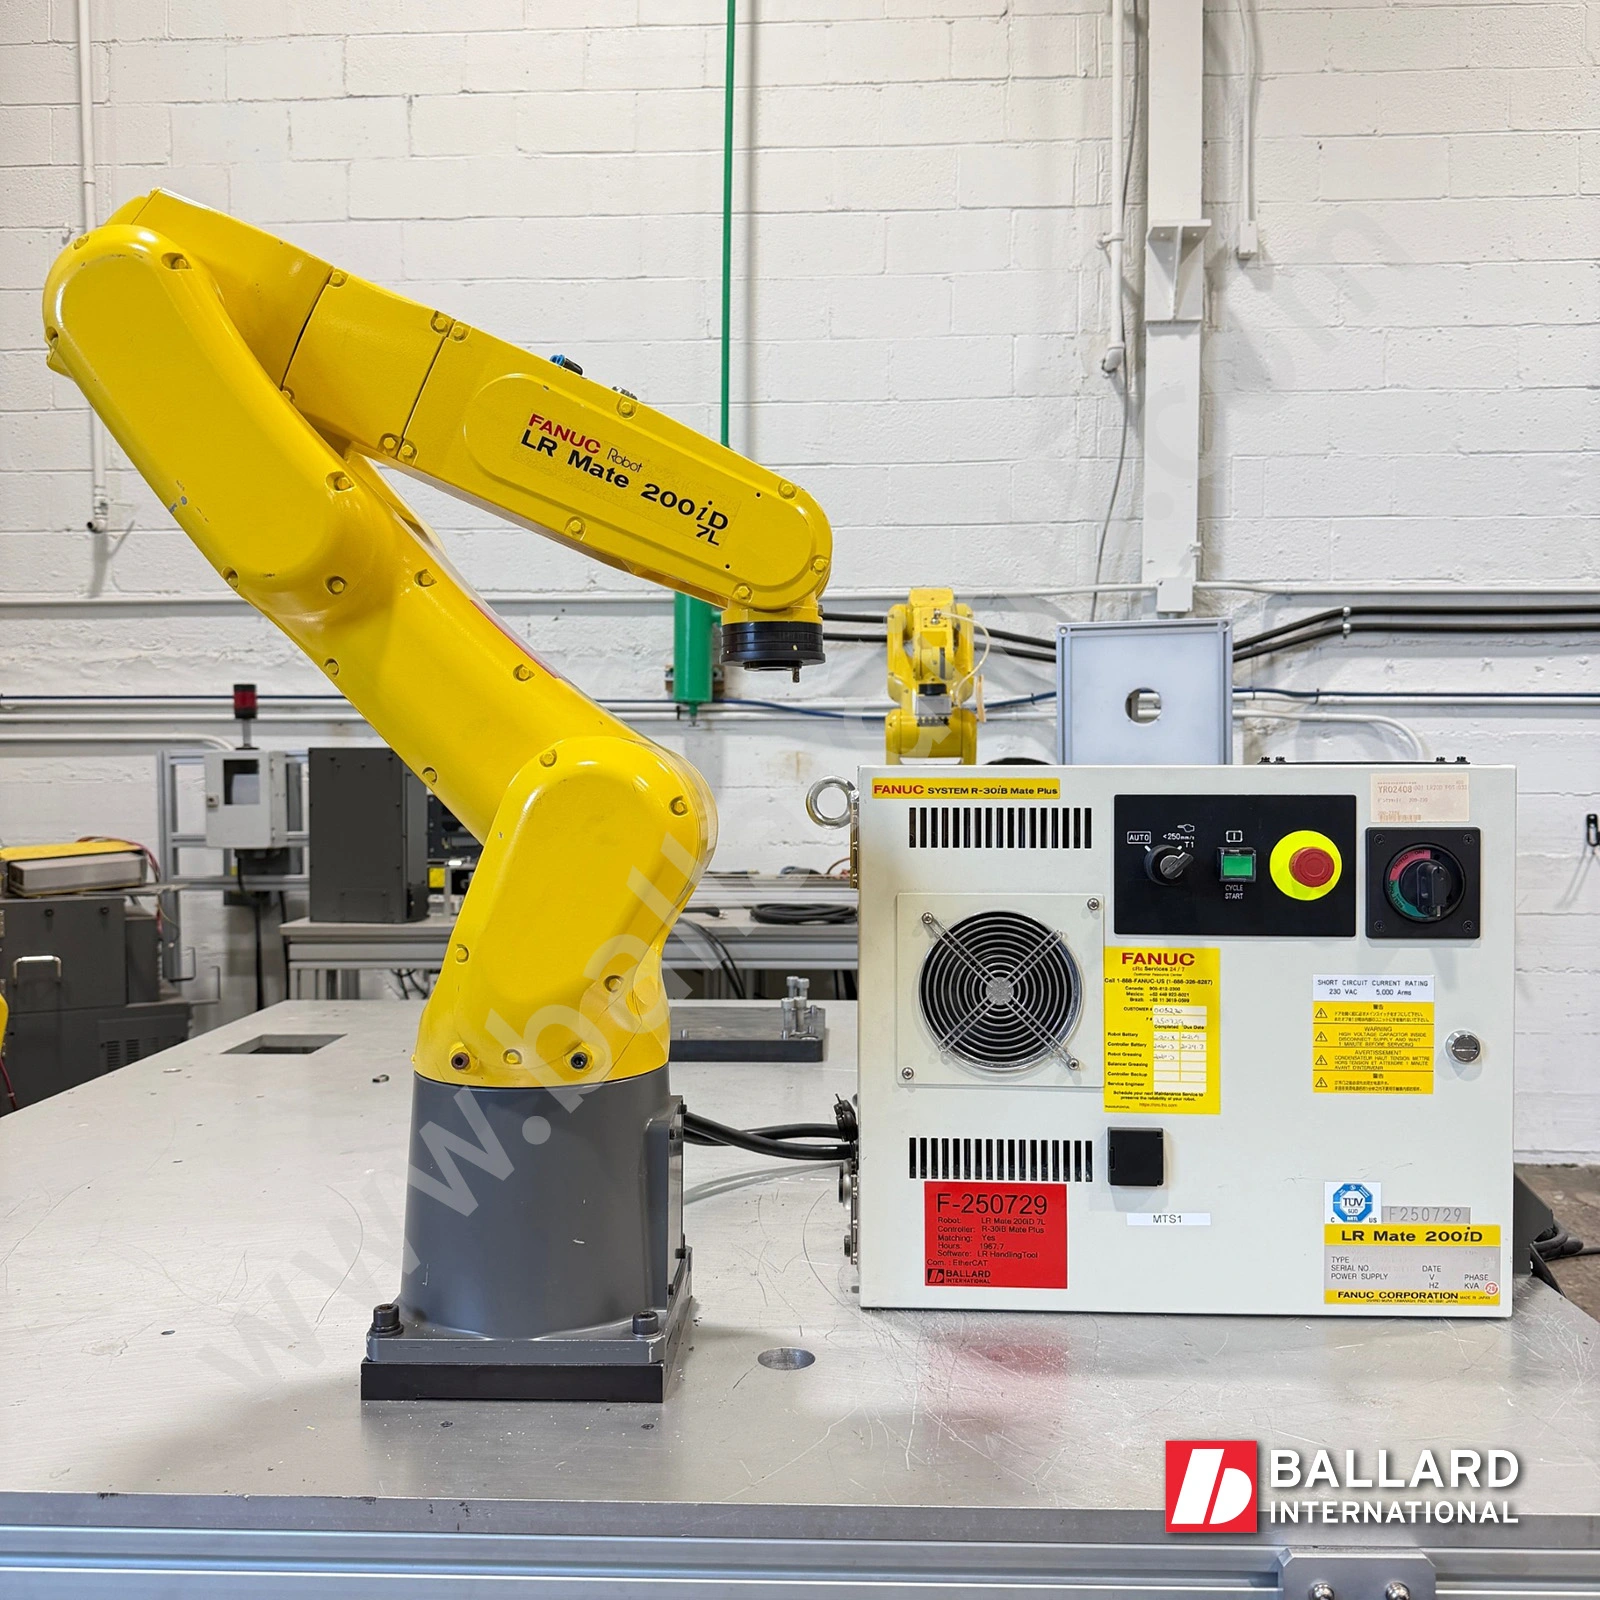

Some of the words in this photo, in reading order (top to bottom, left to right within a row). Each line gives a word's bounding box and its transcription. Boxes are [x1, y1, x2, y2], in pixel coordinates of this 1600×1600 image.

[528, 413, 601, 454] FANUC
[606, 447, 643, 472] Robot
[520, 428, 558, 458] LR
[567, 450, 630, 488] Mate
[640, 483, 729, 530] 200iD
[696, 524, 720, 546] 7L
[874, 784, 924, 795] FANUC
[971, 785, 1007, 795] R-30iB
[1122, 952, 1195, 966] FANUC
[937, 1193, 1047, 1215] F-250729
[1343, 1198, 1363, 1206] TÜV
[1153, 1214, 1182, 1223] MTS1
[1389, 1207, 1462, 1221] F250729
[1342, 1230, 1364, 1241] LR
[1374, 1231, 1416, 1242] Mate
[1425, 1226, 1482, 1242] 200iD
